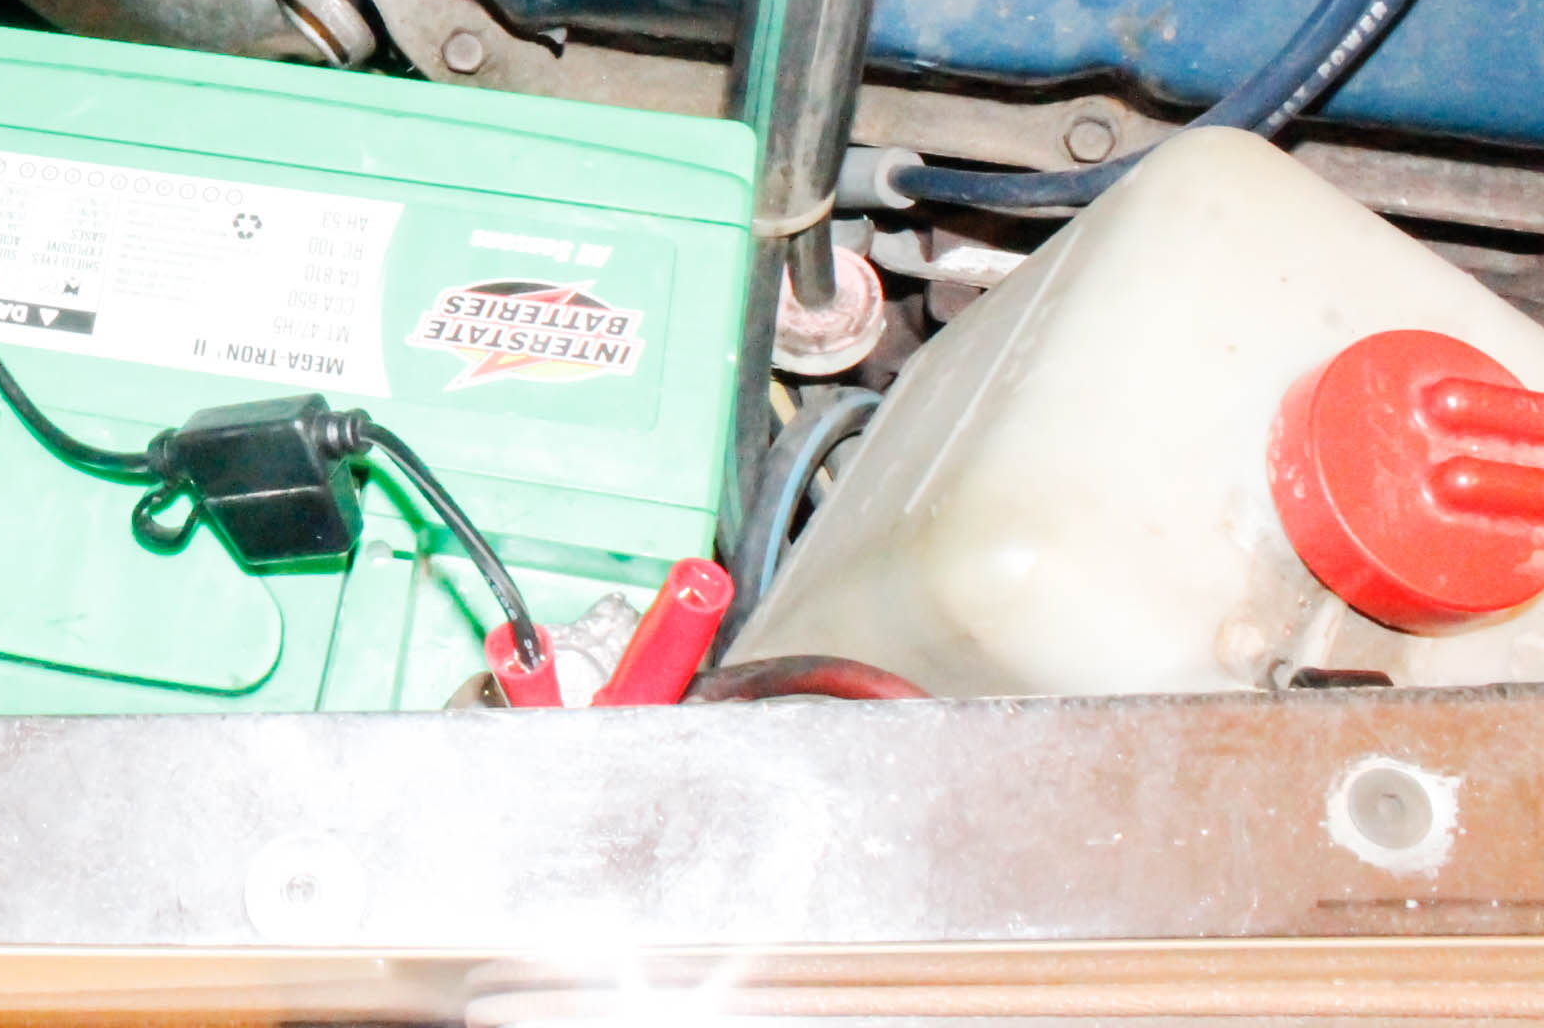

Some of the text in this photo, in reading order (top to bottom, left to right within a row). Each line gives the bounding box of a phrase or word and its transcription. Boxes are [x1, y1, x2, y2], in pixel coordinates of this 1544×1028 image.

[1317, 1, 1388, 79] POWER
[444, 294, 628, 336] BATTERIES
[424, 319, 631, 364] INTERSTATE
